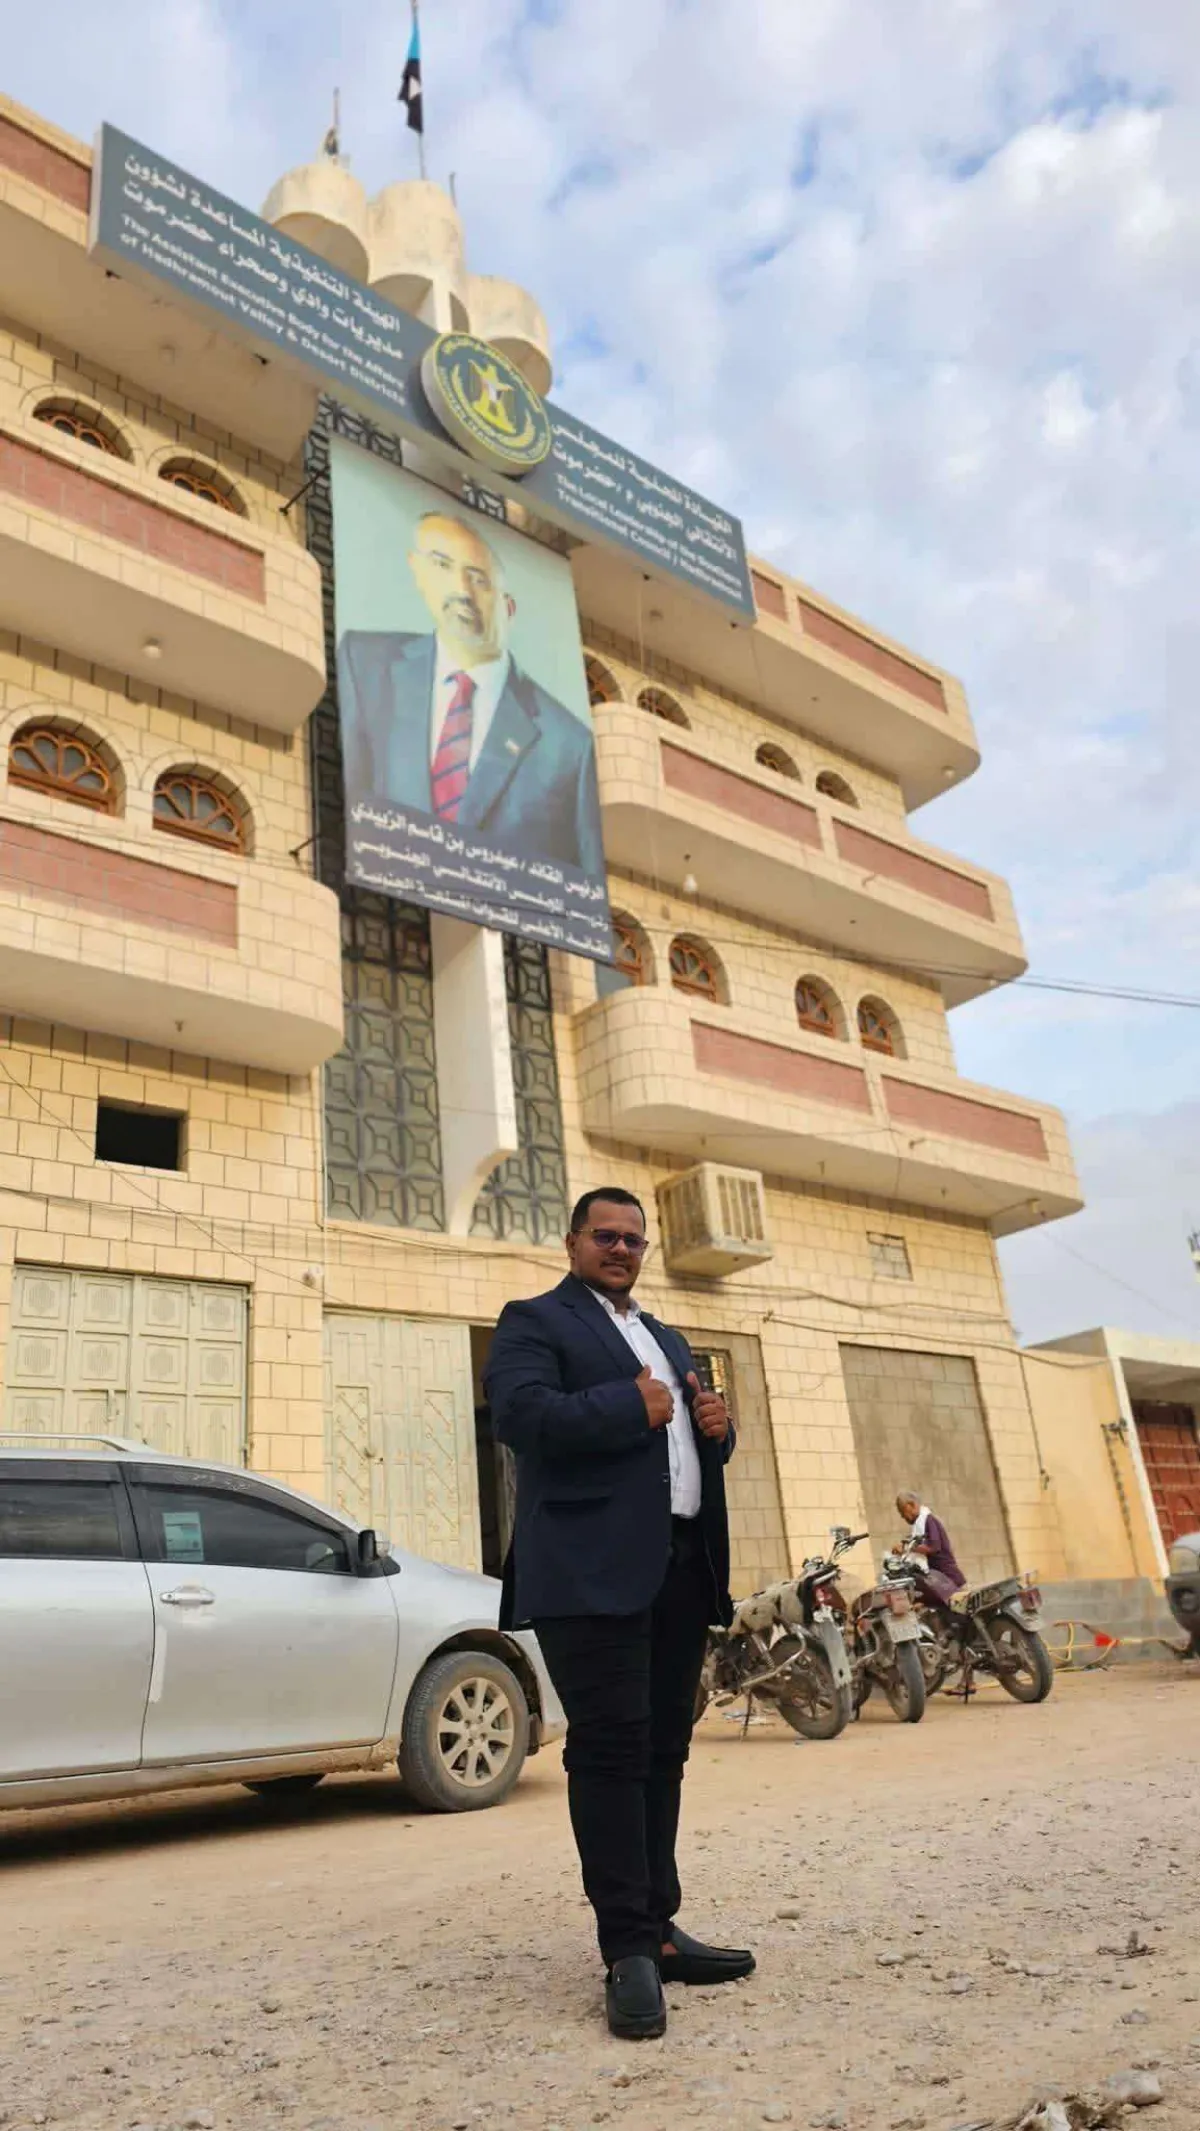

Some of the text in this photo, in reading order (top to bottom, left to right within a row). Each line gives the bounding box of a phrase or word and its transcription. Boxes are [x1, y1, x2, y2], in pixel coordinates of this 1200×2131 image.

[123, 178, 215, 242] حضرموت
[190, 188, 265, 248] المساعدة
[119, 232, 138, 248] of
[141, 242, 236, 308] Hadhramout
[239, 298, 284, 336] Valley
[286, 326, 298, 342] &
[301, 336, 347, 371] Desert
[348, 364, 406, 407] Districts
[121, 212, 405, 392] The Assistant Executive Body for the Affairs
[555, 471, 578, 495] The
